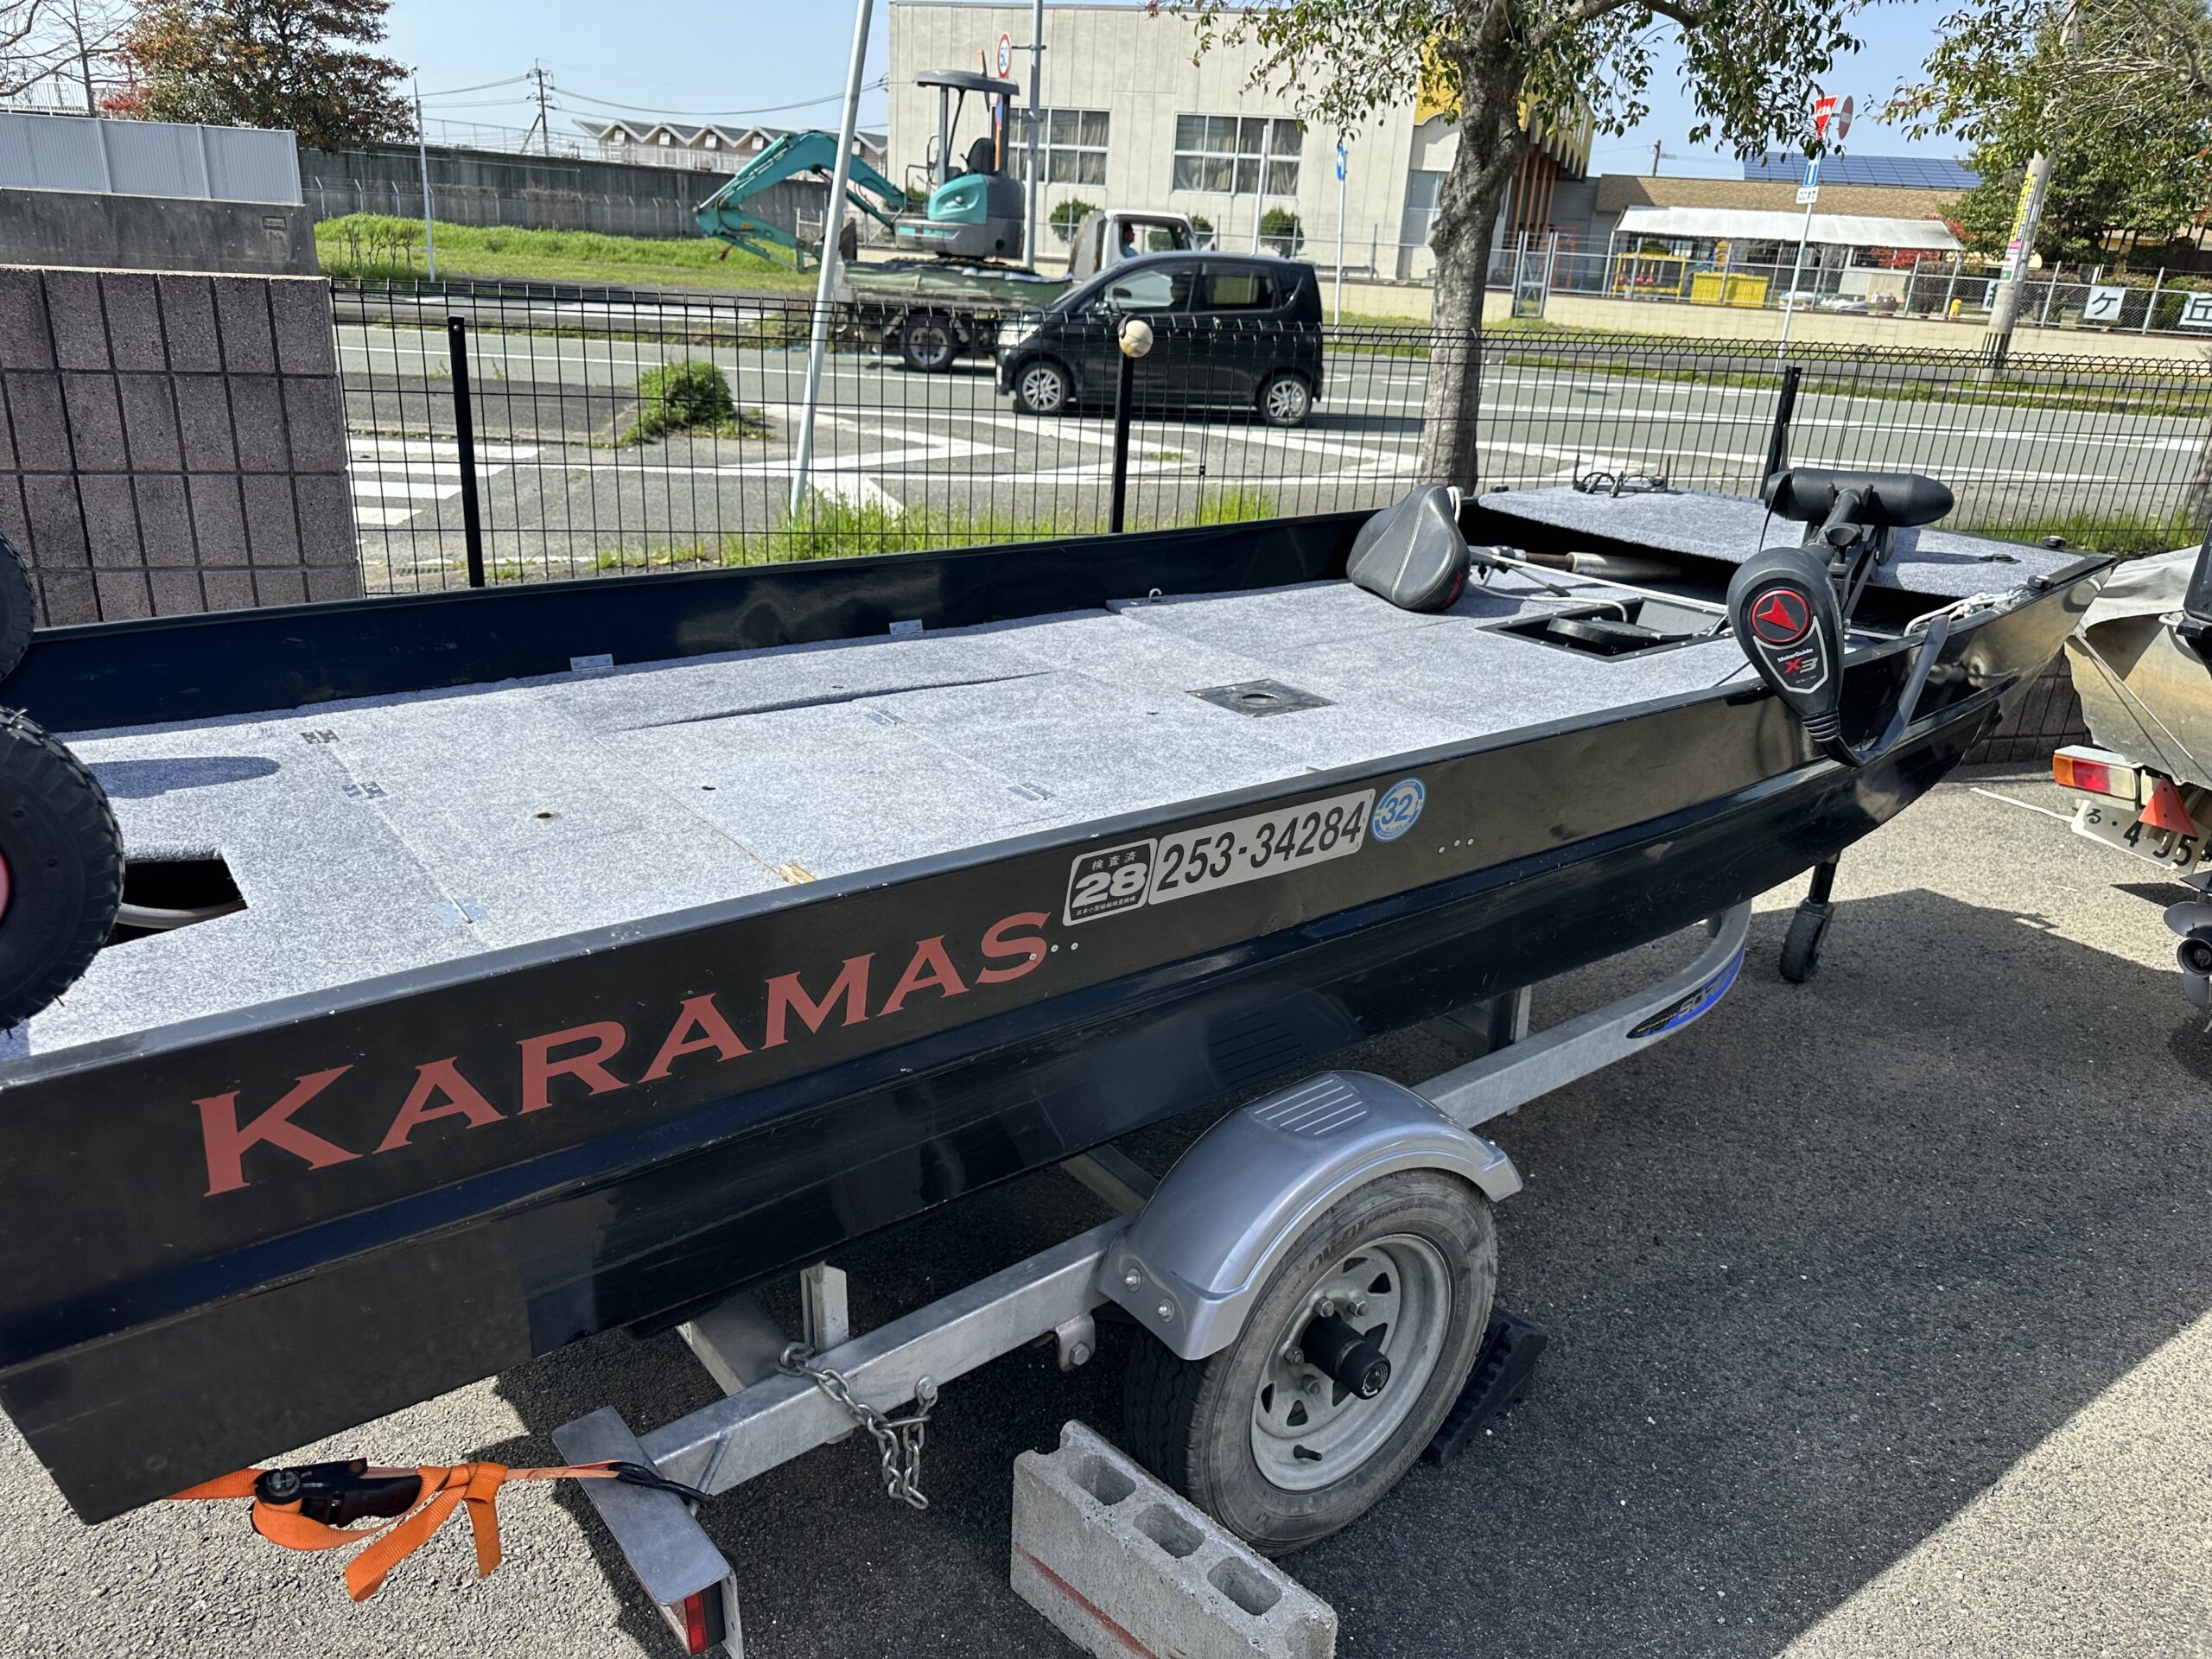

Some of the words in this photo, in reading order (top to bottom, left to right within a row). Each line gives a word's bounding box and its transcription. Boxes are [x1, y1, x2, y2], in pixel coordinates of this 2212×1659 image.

[1783, 657, 1818, 675] X3
[1381, 793, 1413, 825] 32
[1091, 850, 1137, 871] 検査済
[1156, 801, 1365, 892] 253-34284
[1071, 862, 1147, 909] 28
[192, 911, 1052, 1198] KARAMAS
